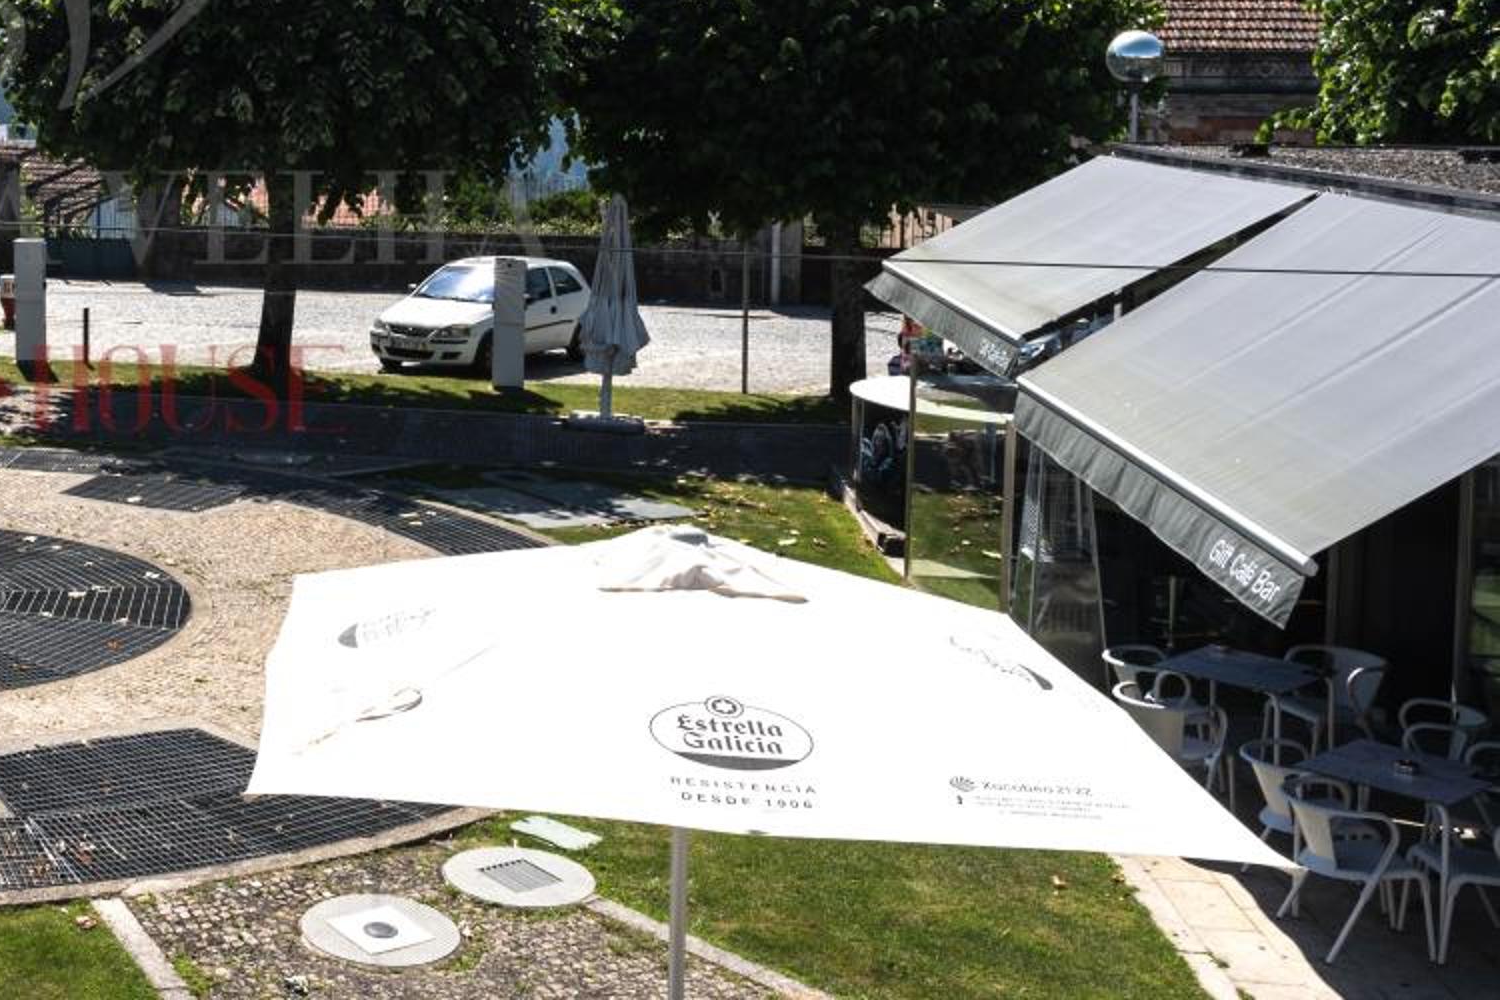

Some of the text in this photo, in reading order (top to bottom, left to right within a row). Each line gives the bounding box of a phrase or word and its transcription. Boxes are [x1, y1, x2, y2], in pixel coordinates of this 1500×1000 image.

[1251, 569, 1280, 602] Bar
[677, 714, 783, 737] Estrella
[684, 731, 783, 754] Galicia
[670, 776, 817, 794] RESISTENCIA
[681, 791, 751, 805] DESDE
